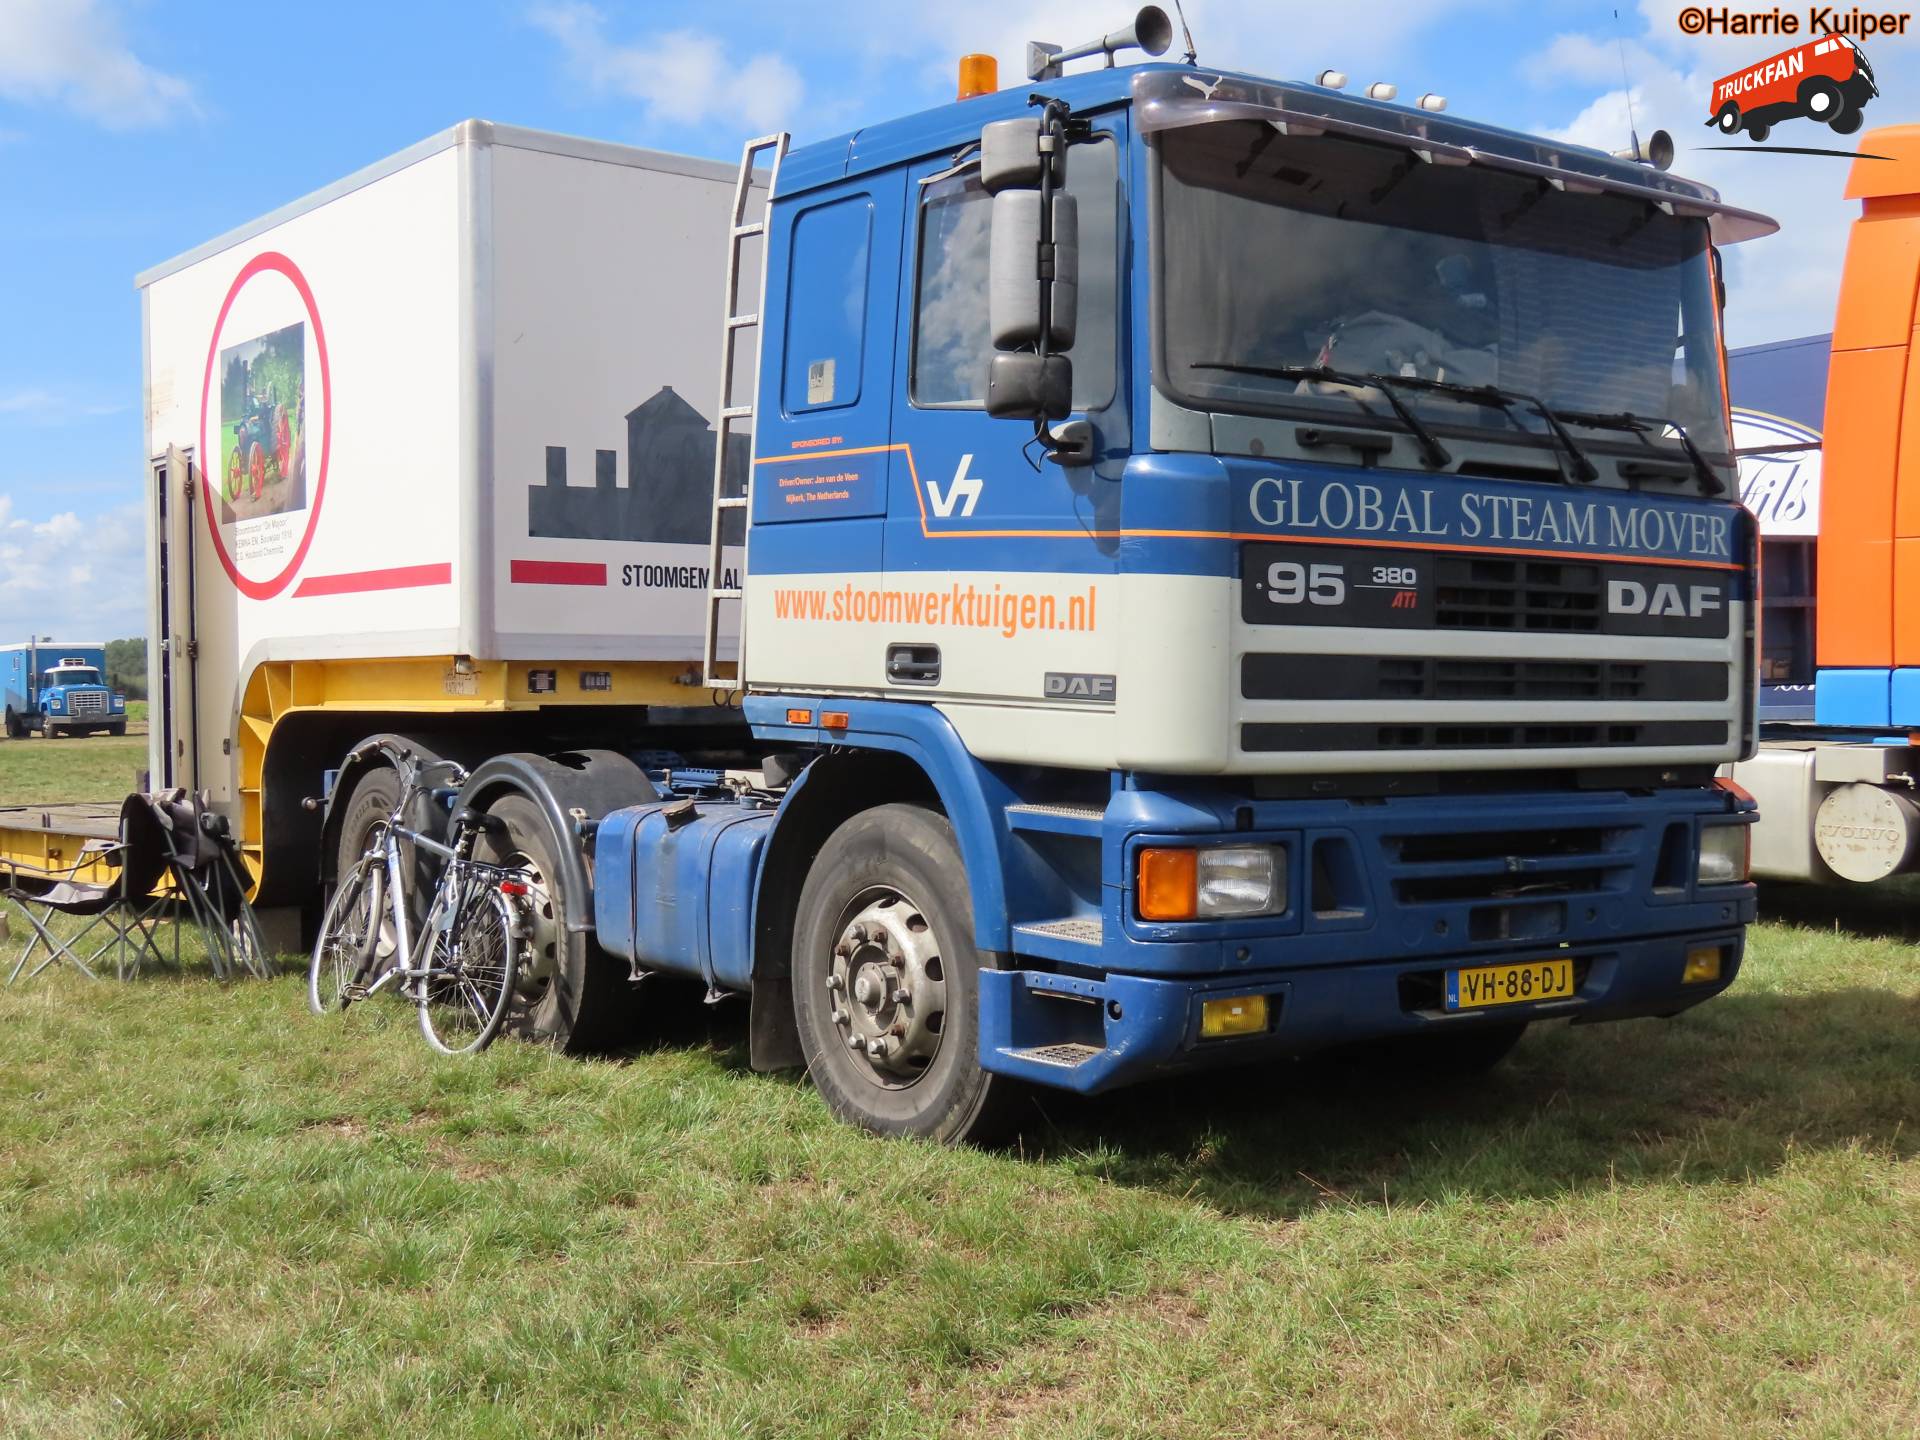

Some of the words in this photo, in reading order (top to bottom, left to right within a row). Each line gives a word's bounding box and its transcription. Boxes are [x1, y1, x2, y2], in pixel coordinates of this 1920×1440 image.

[815, 475, 825, 484] Jan
[826, 475, 836, 483] van
[836, 474, 844, 482] de
[806, 492, 816, 501] The
[817, 491, 849, 500] Netherlands
[1248, 476, 1448, 536] GLOBAL
[1460, 492, 1598, 546] STEAM
[1607, 505, 1730, 556] MOVER
[622, 564, 743, 590] STOOMGEMAL
[1266, 561, 1346, 606] 95
[1372, 566, 1417, 586] 380
[774, 583, 1097, 638] www.stoomwerktuigen.nl
[1607, 580, 1721, 618] DAF
[1046, 676, 1113, 697] DAF
[1821, 824, 1900, 842] VOLVO
[1448, 993, 1458, 1003] NL
[1466, 964, 1566, 1002] VH-88-DJ
